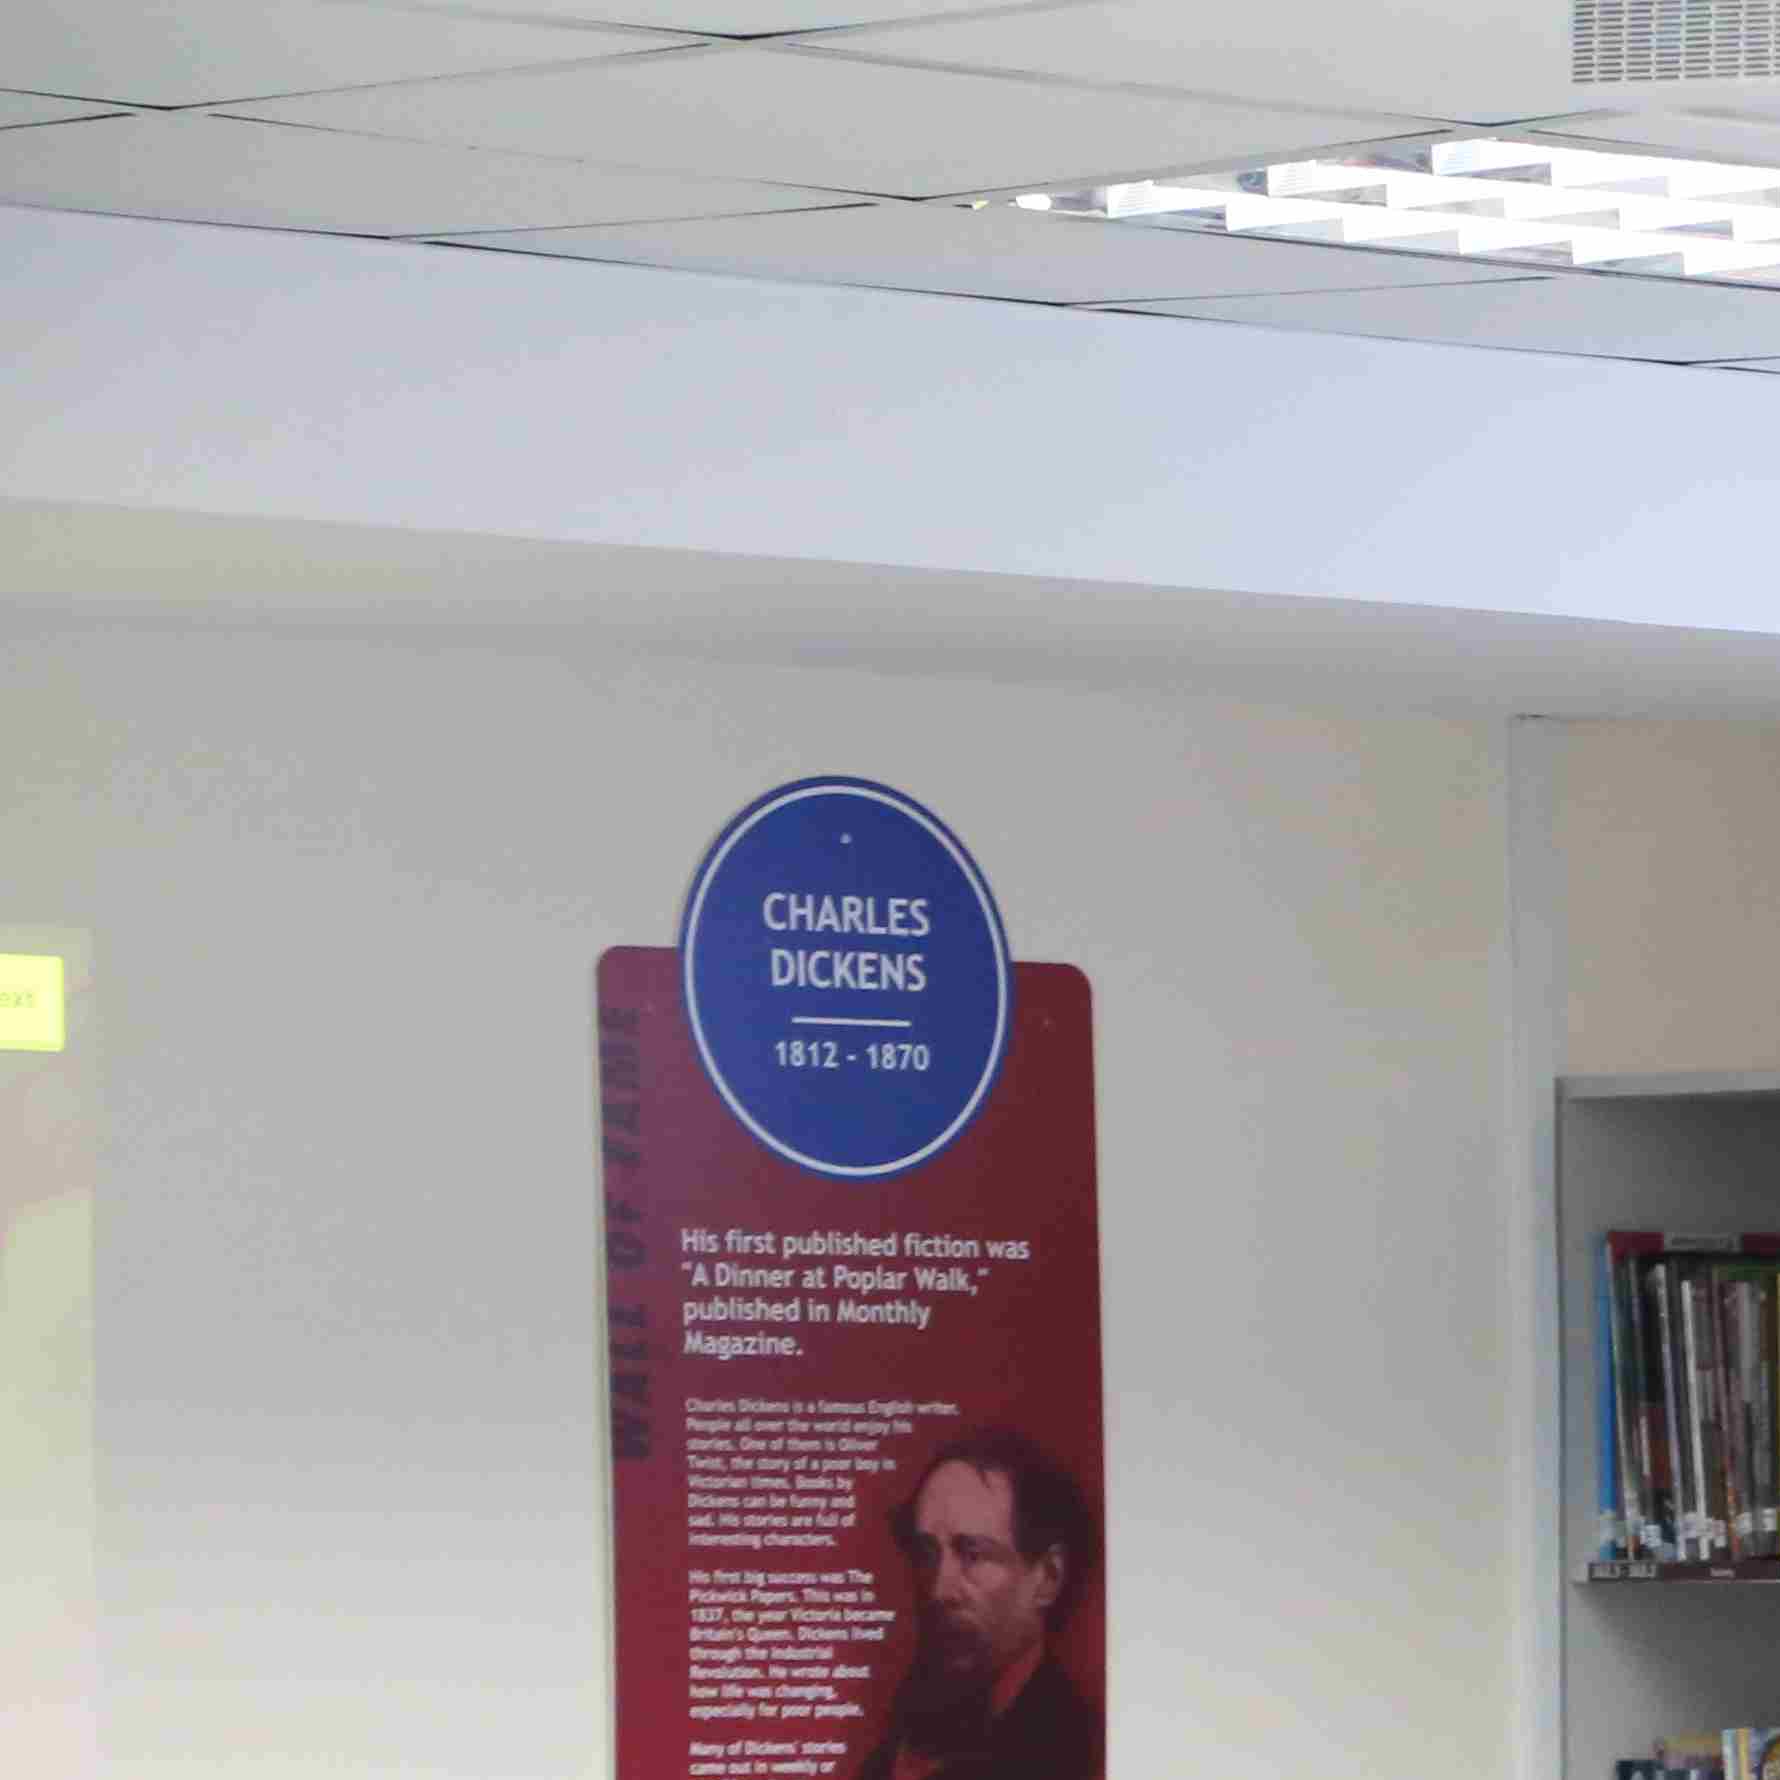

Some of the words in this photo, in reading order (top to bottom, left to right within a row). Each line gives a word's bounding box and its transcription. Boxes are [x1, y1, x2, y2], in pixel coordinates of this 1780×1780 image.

[763, 892, 930, 936] CHARLES
[771, 949, 926, 991] DICKENS
[775, 1042, 838, 1068] 1812
[866, 1044, 929, 1070] 1870
[682, 1230, 718, 1254] His
[725, 1230, 775, 1254] first
[782, 1232, 896, 1258] published
[904, 1235, 978, 1258] fiction
[986, 1240, 1029, 1258] was
[716, 1264, 794, 1288] Dinner
[802, 1268, 825, 1288] at
[834, 1266, 906, 1295] Poplar
[682, 1299, 800, 1324] published
[808, 1301, 830, 1322] in
[836, 1301, 930, 1326] Monthly
[684, 1332, 804, 1358] Magazine.
